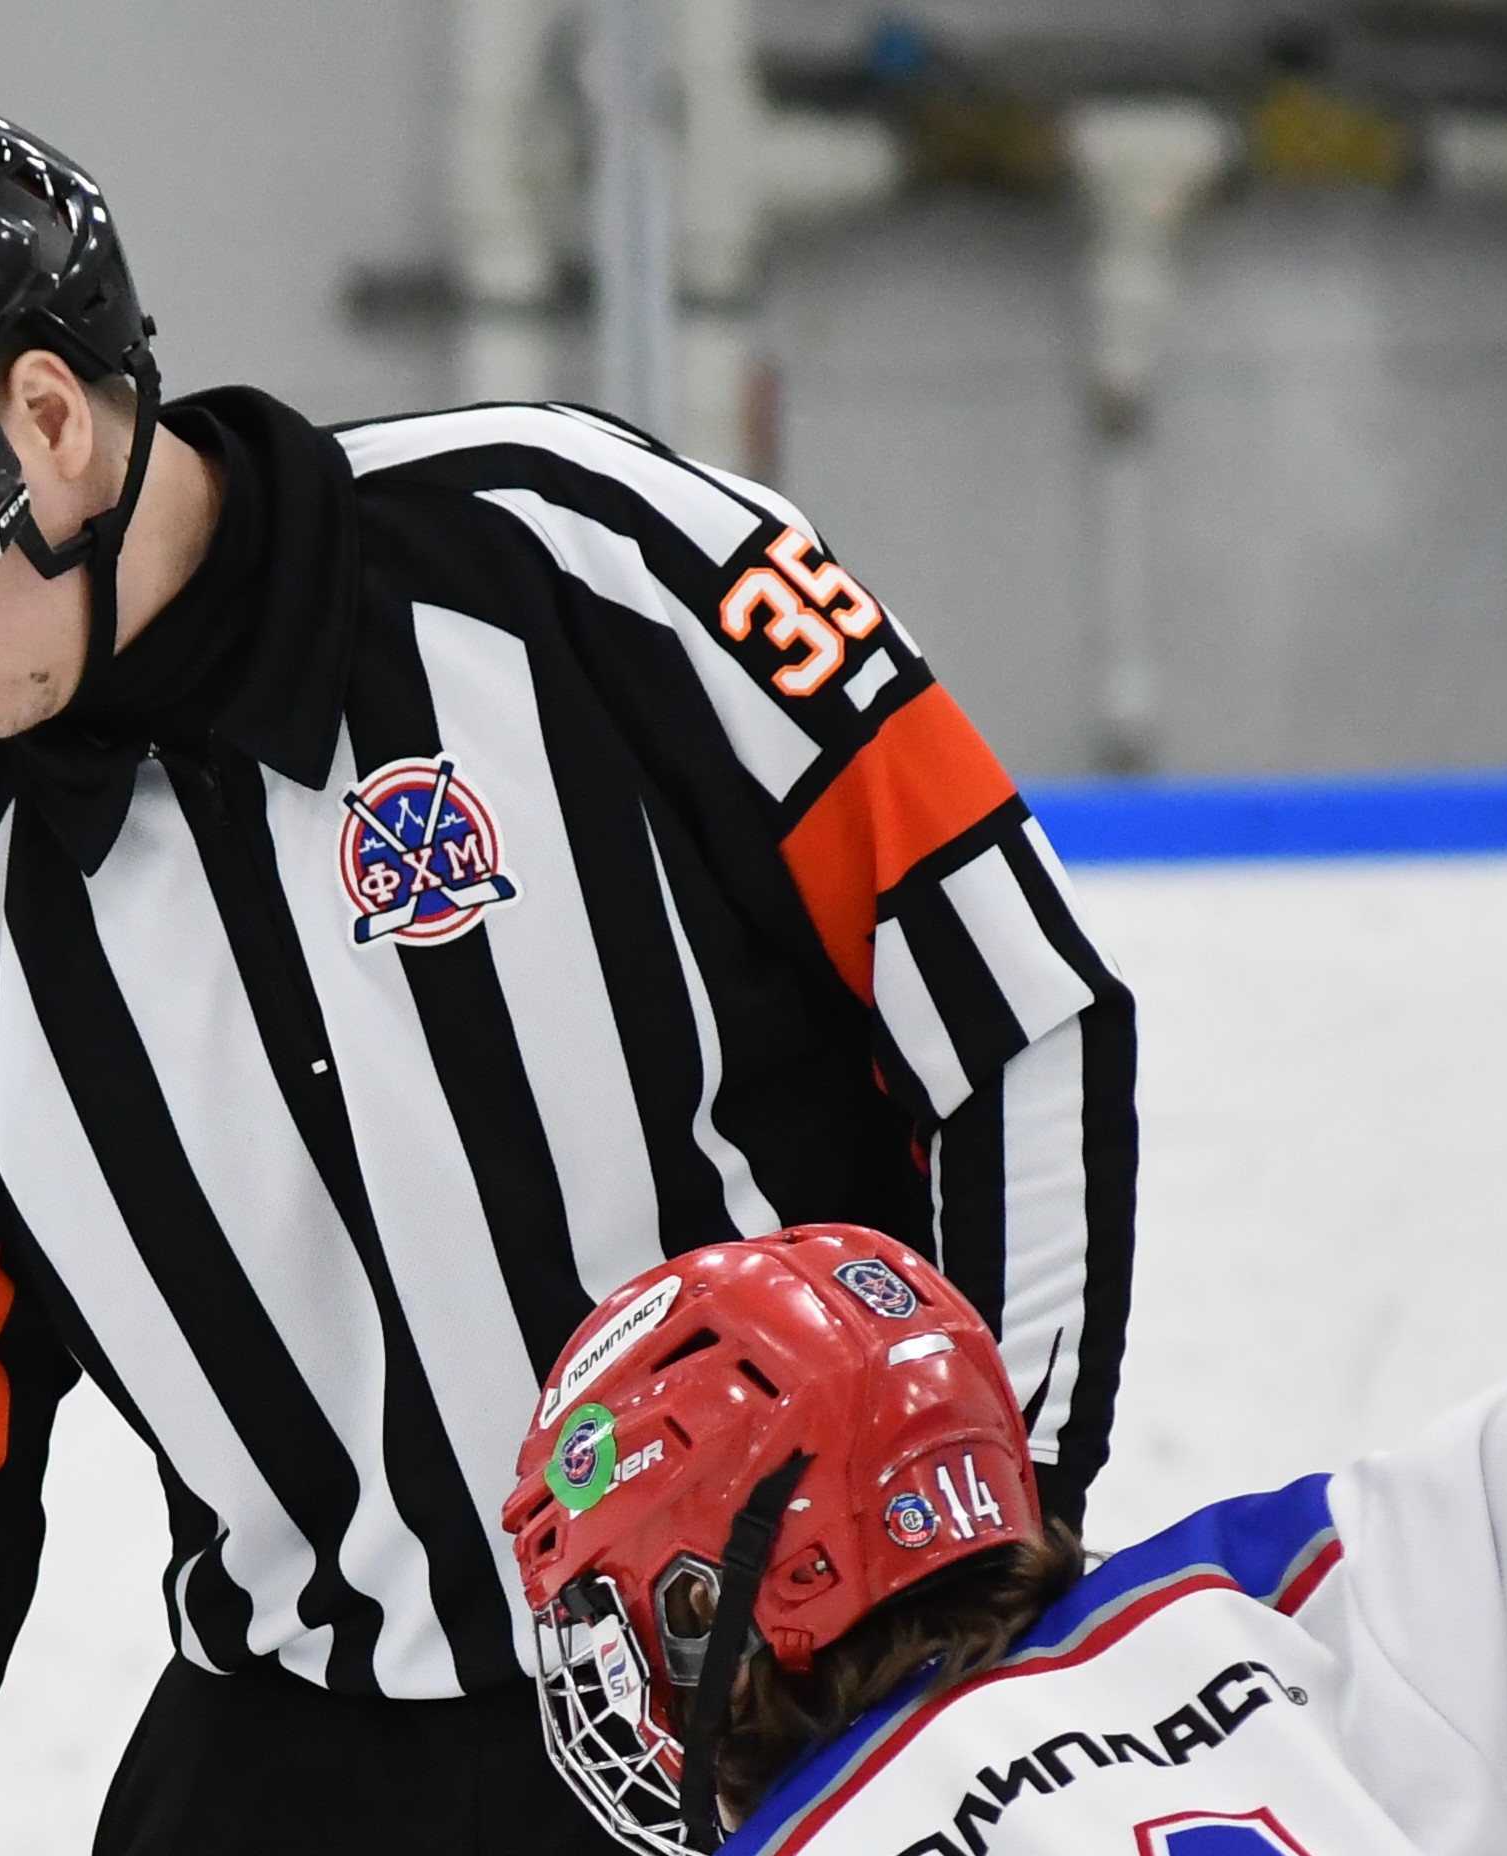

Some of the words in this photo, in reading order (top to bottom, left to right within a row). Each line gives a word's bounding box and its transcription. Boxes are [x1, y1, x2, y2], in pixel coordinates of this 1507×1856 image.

[0, 488, 30, 529] CCM
[720, 526, 883, 697] 35
[360, 832, 491, 905] ФХМ
[566, 1291, 668, 1389] ПОЛИПЛАСТ
[936, 1452, 1003, 1540] 14
